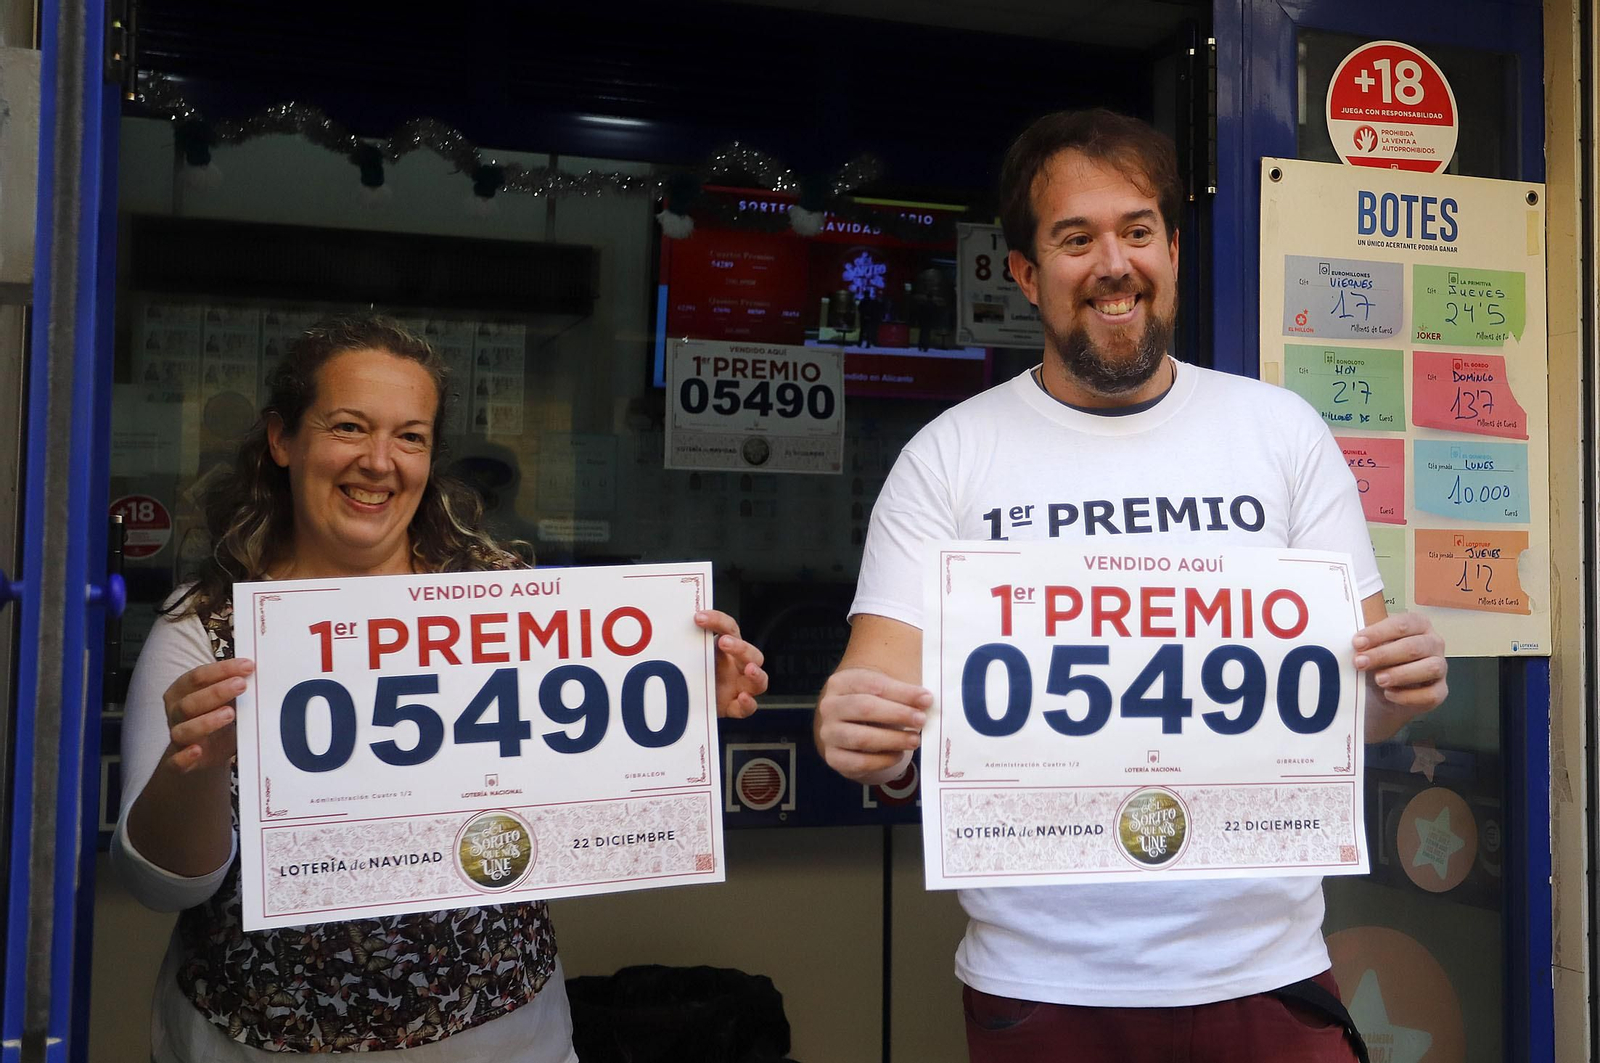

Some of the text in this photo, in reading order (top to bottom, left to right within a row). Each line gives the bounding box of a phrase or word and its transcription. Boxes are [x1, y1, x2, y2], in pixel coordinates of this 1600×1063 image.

[1354, 58, 1425, 106] +18
[1341, 107, 1443, 119] JUEGA CON RESPONSABILIDAD
[1382, 146, 1435, 154] AUTOPROHIBIDOS
[1358, 190, 1458, 243] BOTES
[1367, 239, 1384, 247] ÚNICO
[1386, 242, 1417, 250] ACERTANTE
[1330, 290, 1376, 322] 17
[1371, 325, 1378, 334] de
[1416, 332, 1441, 341] JOKER
[730, 346, 787, 356] VENDIDO AQUÍ
[714, 357, 821, 383] PREMIO
[680, 378, 835, 420] 05490
[1379, 414, 1393, 422] Euros
[1496, 420, 1503, 428] de
[1465, 460, 1494, 470] LUNES
[1448, 474, 1511, 505] 10.000
[1048, 494, 1266, 538] PREMIO
[1380, 506, 1394, 515] Euros
[1504, 509, 1518, 517] Euros
[1465, 546, 1501, 559] JUEVES
[1084, 555, 1224, 573] VENDIDO AQUÍ
[408, 578, 562, 602] VENDIDO AQUÍ
[1478, 597, 1520, 606] Millones de Euros
[990, 584, 1309, 640] 1er PREMIO
[308, 606, 653, 673] 1er PREMIO
[961, 642, 1341, 738] 05490
[280, 660, 690, 773] 05490
[624, 771, 666, 779] GIBRALEON
[310, 794, 369, 804] Administración
[400, 790, 413, 798] 1/2
[461, 788, 523, 799] LOTERÍA NACIONAL
[1128, 808, 1177, 832] SORTEO
[1140, 821, 1176, 836] QUE NOS
[1224, 820, 1321, 831] 22 DICIEMBRE
[956, 822, 1104, 839] LOTERÍA de NAVIDAD
[470, 830, 521, 857] SORTEO
[572, 830, 676, 849] 22 DICIEMBRE
[1136, 836, 1168, 858] UNE
[482, 850, 500, 860] QUE
[280, 852, 443, 877] LOTERÍA de NAVIDAD
[480, 858, 512, 881] UNE
